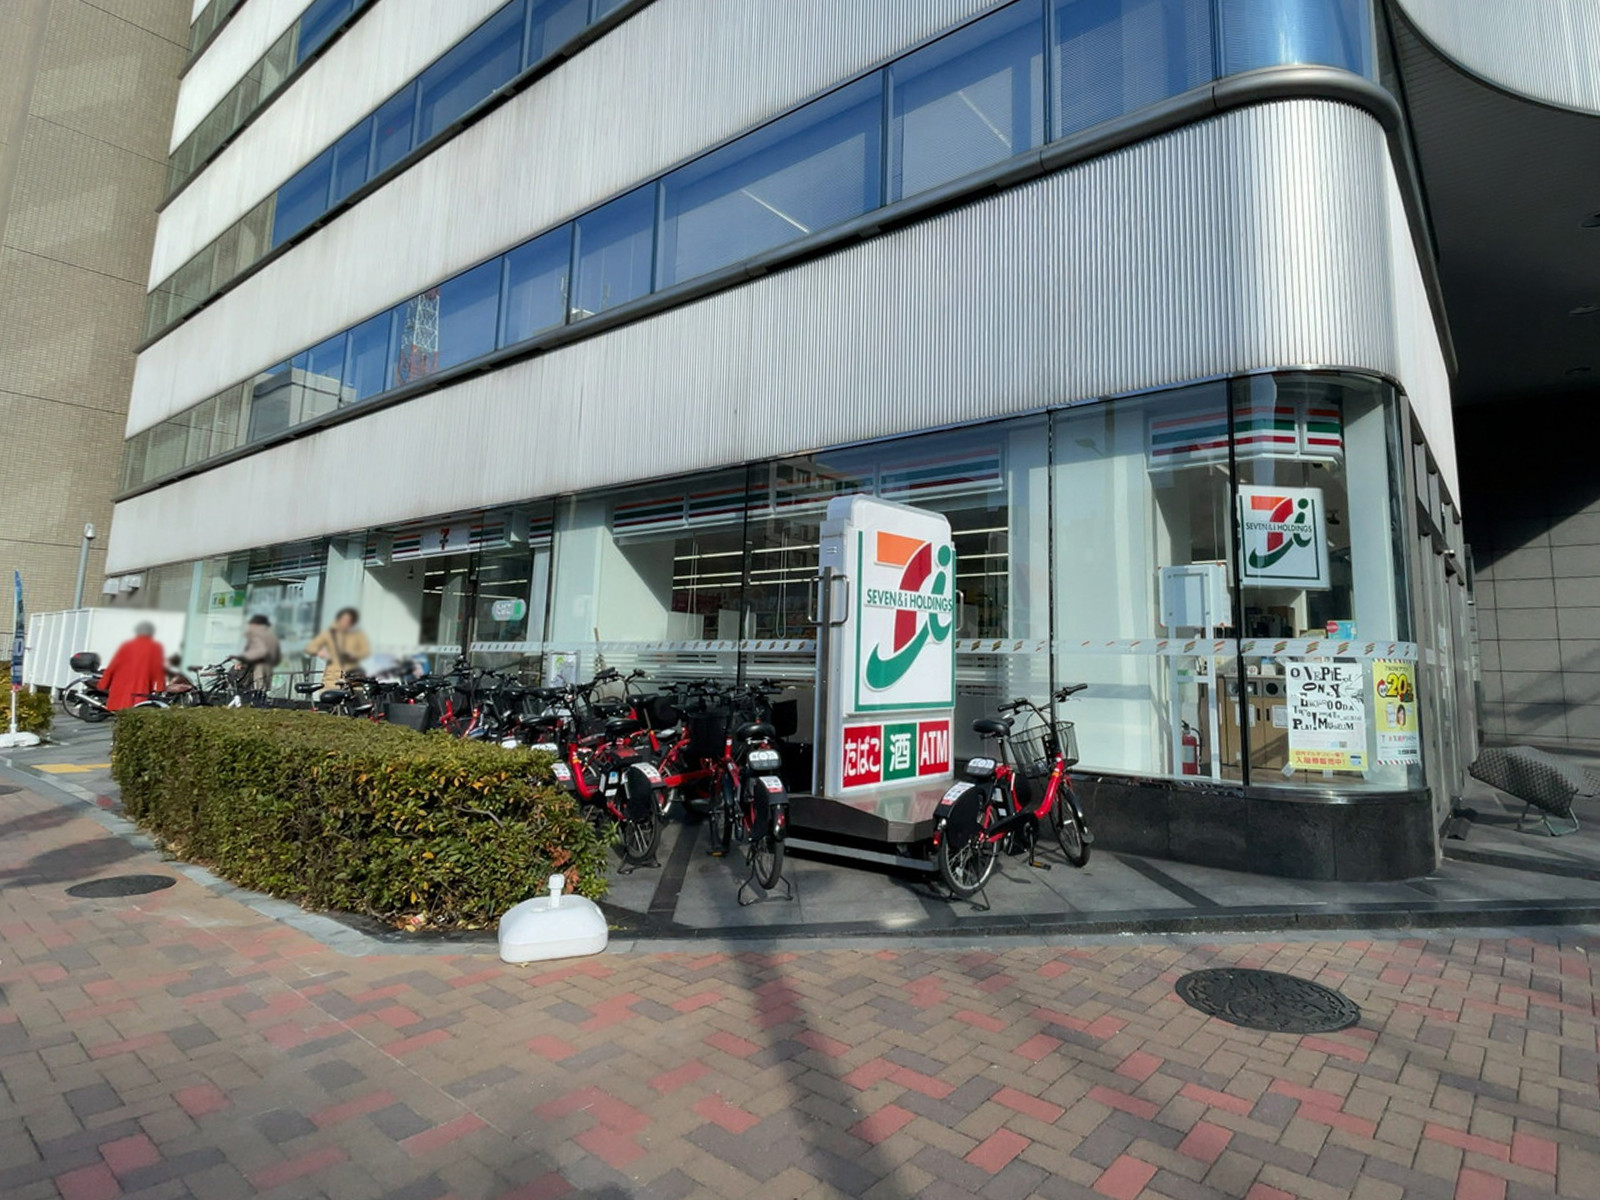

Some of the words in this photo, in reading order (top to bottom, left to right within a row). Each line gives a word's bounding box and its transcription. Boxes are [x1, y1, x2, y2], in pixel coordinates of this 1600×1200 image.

[1278, 523, 1312, 533] HOLDINGS
[910, 594, 953, 612] HOLDINGS
[844, 735, 881, 778] たばこ
[889, 733, 911, 772] 酒
[920, 729, 949, 766] ATM
